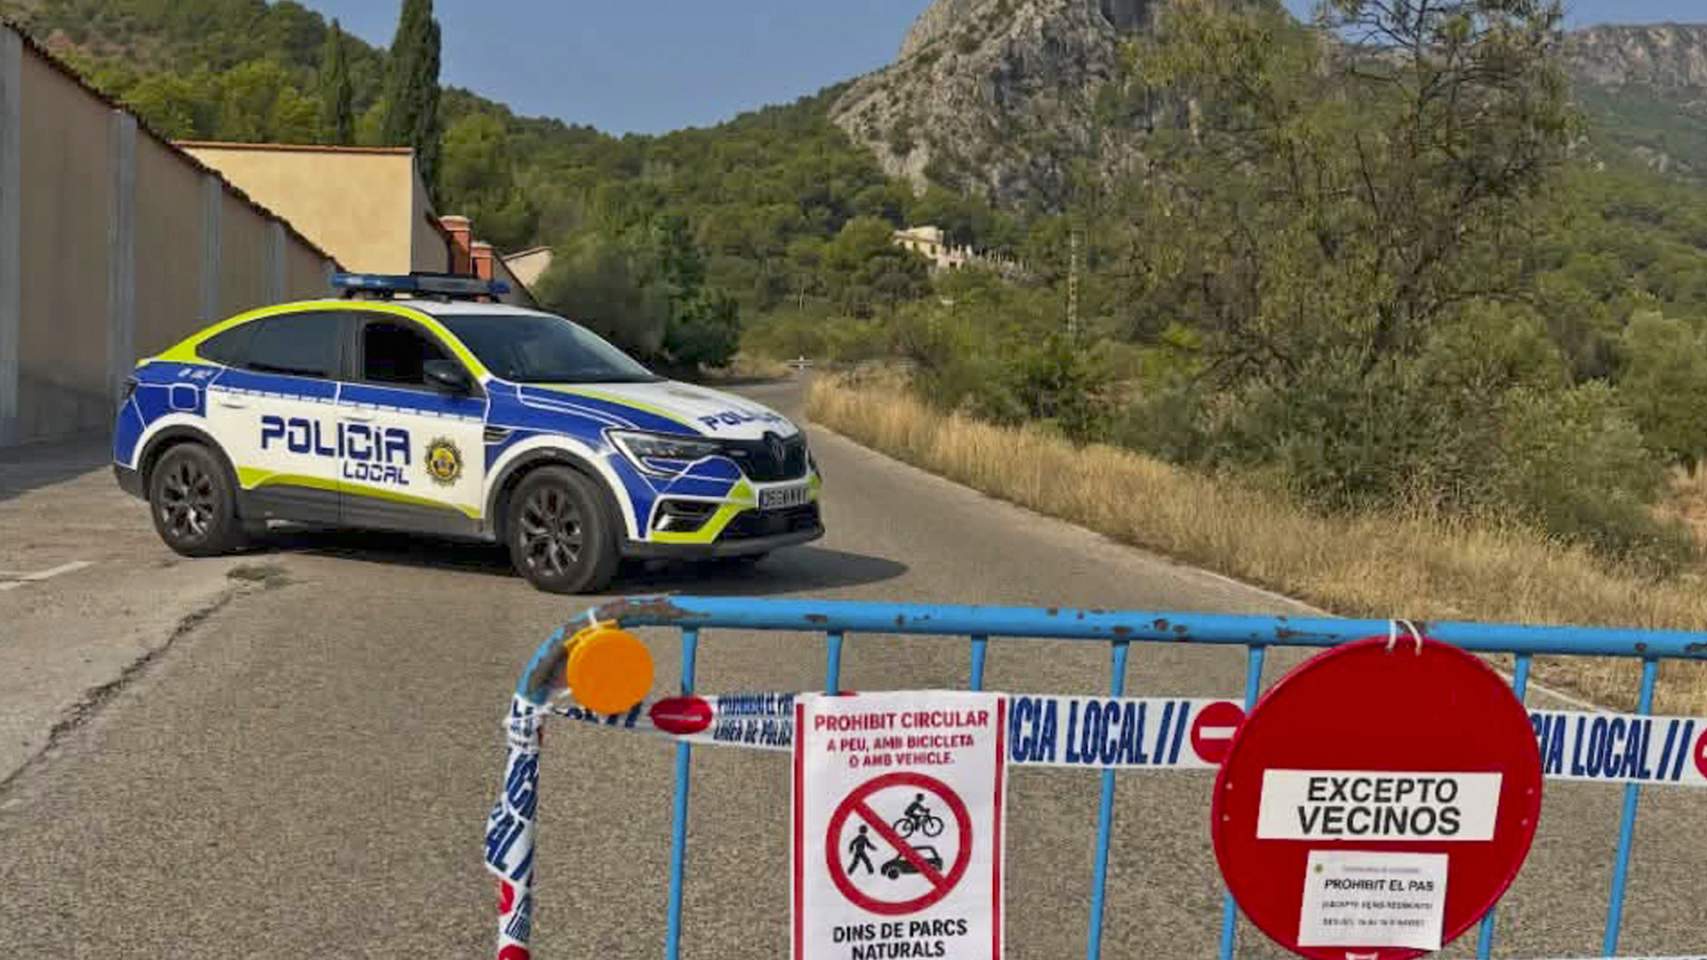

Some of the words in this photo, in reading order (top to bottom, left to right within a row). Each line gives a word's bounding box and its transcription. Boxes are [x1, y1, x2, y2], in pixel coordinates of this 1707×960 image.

[344, 461, 410, 485] LOCAL
[814, 713, 897, 731] PROHIBIT
[901, 710, 989, 728] CIRCULAR
[1066, 699, 1148, 764] LOCAL
[827, 738, 836, 751] A
[908, 735, 974, 749] BICICLETA
[1572, 716, 1652, 779] LOCAL
[849, 755, 859, 768] O
[863, 755, 892, 767] AMB
[1307, 777, 1459, 803] EXCEPTO
[1298, 806, 1462, 835] VECINOS
[1325, 879, 1385, 891] PROHIBIT
[1389, 880, 1405, 892] EL
[833, 924, 876, 943] DINS
[881, 922, 904, 939] DE
[909, 919, 968, 937] PARCS
[852, 941, 946, 960] NATURALS
